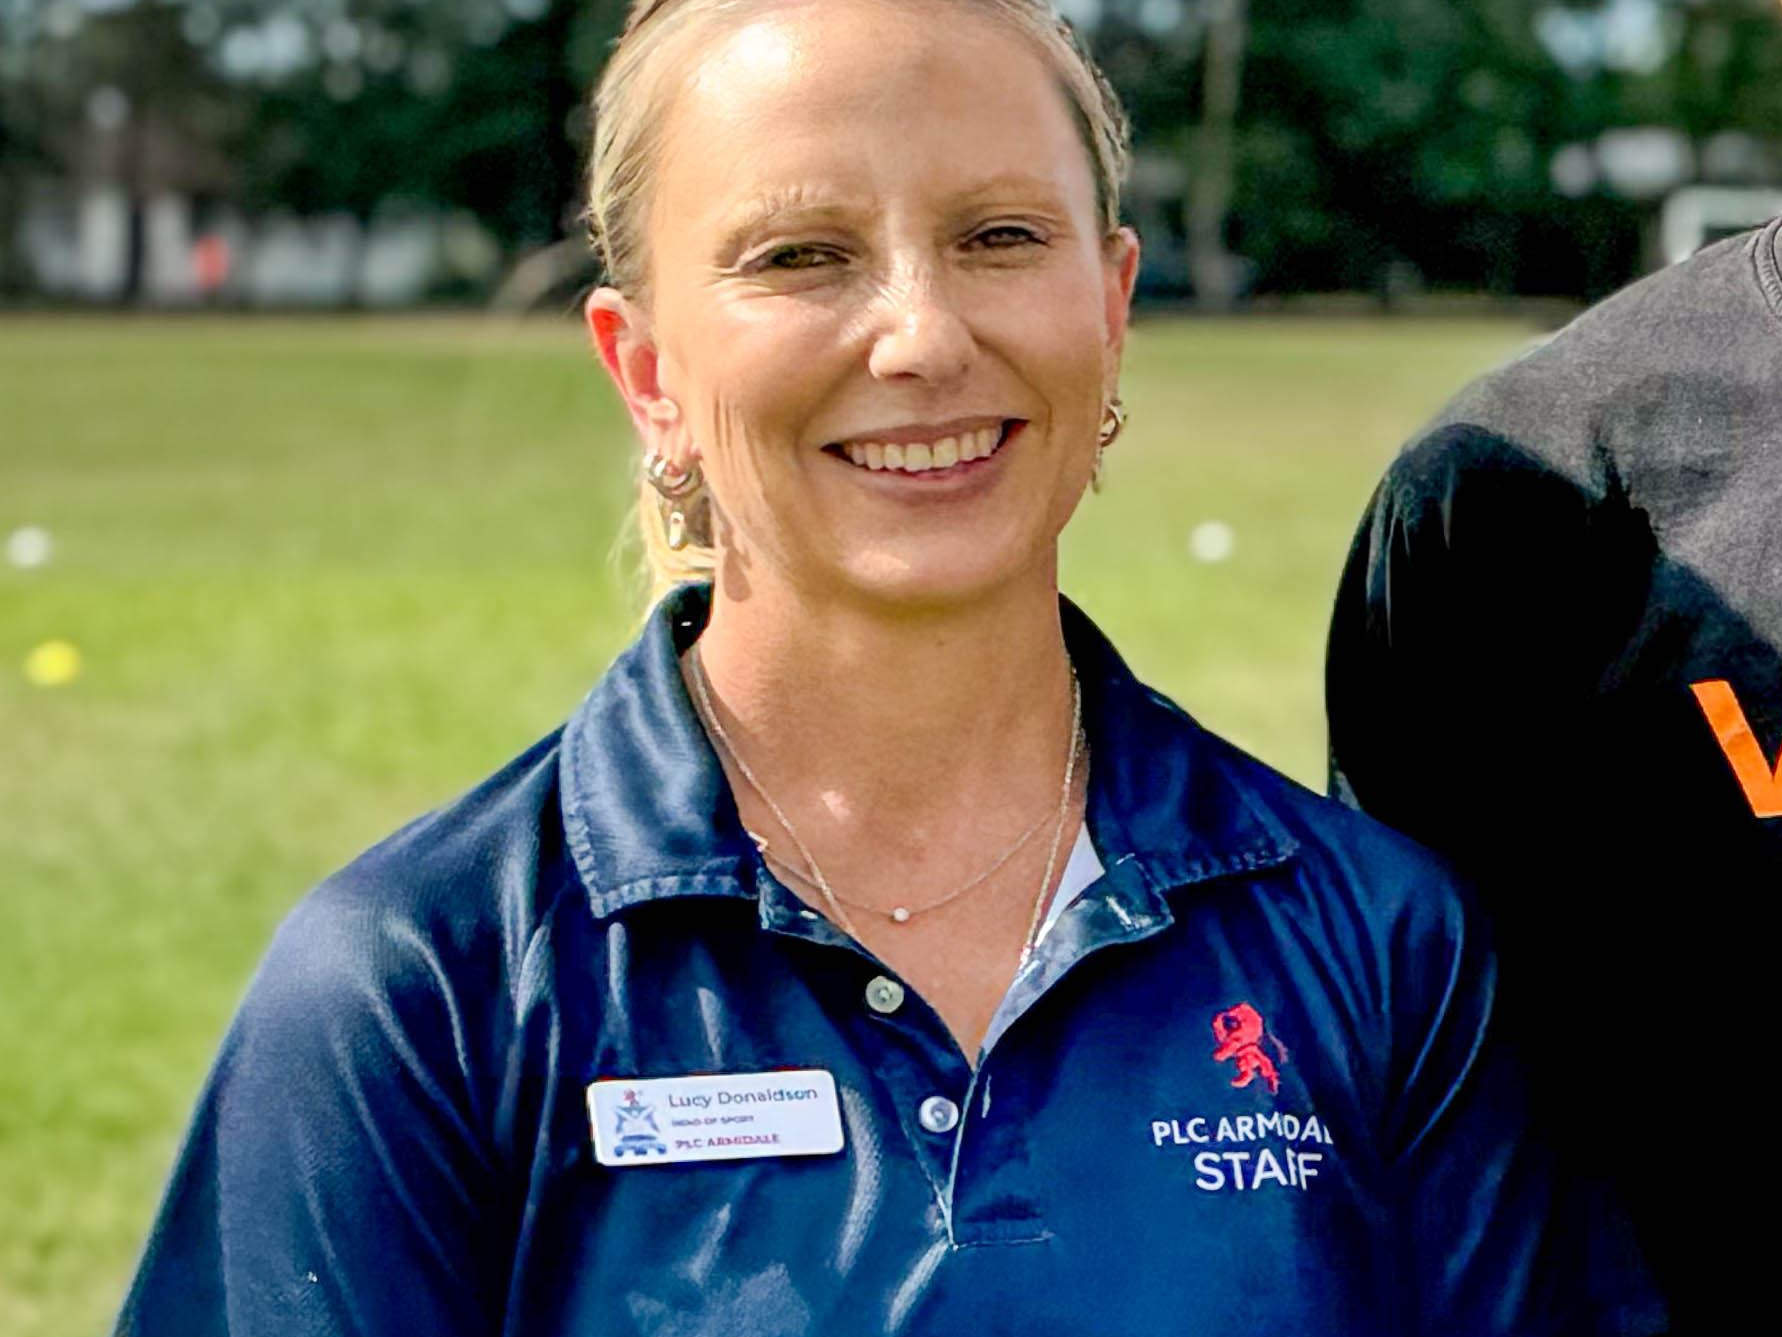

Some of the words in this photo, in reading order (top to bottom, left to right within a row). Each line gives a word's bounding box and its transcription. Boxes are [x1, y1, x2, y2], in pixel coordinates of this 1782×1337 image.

[668, 1093, 712, 1109] Lucy
[717, 1088, 818, 1104] Donaldson
[1151, 1117, 1210, 1147] PLC
